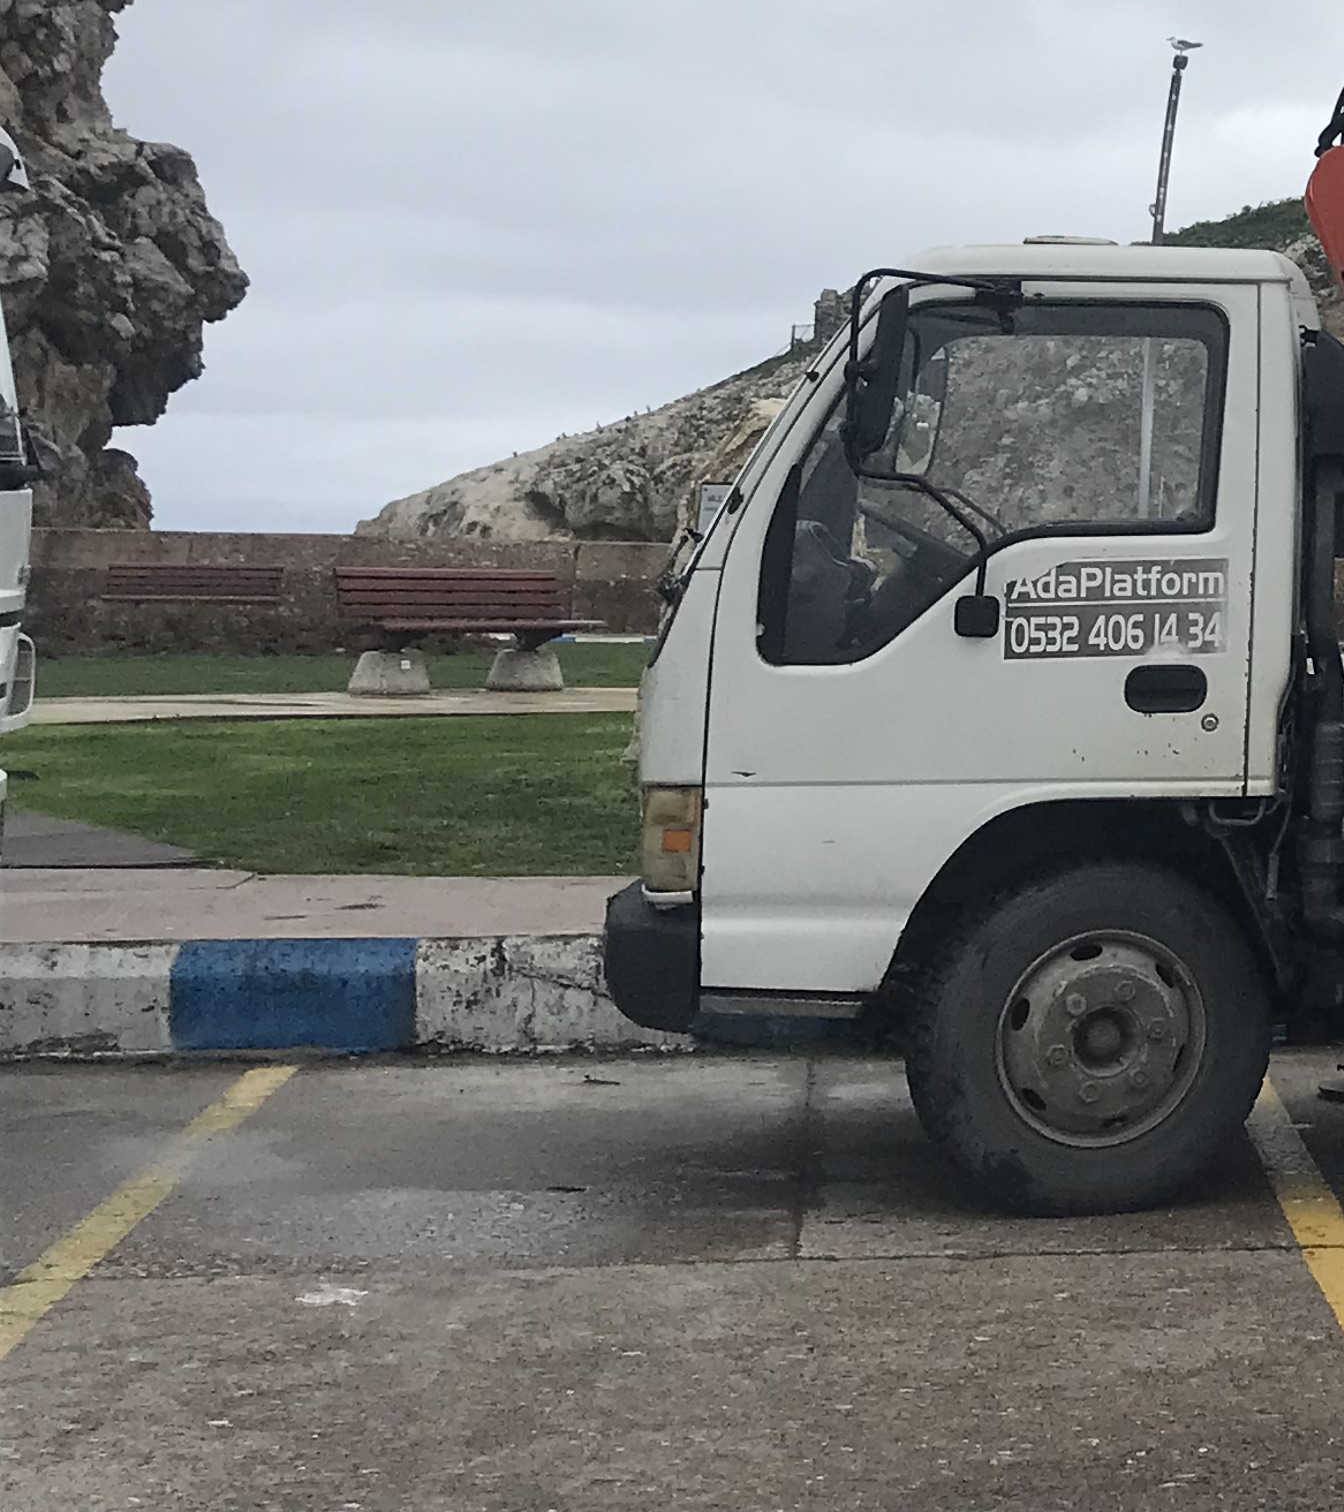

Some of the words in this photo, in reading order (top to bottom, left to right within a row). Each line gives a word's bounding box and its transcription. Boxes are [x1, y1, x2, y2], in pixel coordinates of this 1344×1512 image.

[1010, 565, 1225, 599] AdaPlatform
[1010, 616, 1080, 653] 0532
[1088, 614, 1144, 651] 406
[1154, 613, 1179, 647] 14
[1187, 612, 1222, 648] 34
